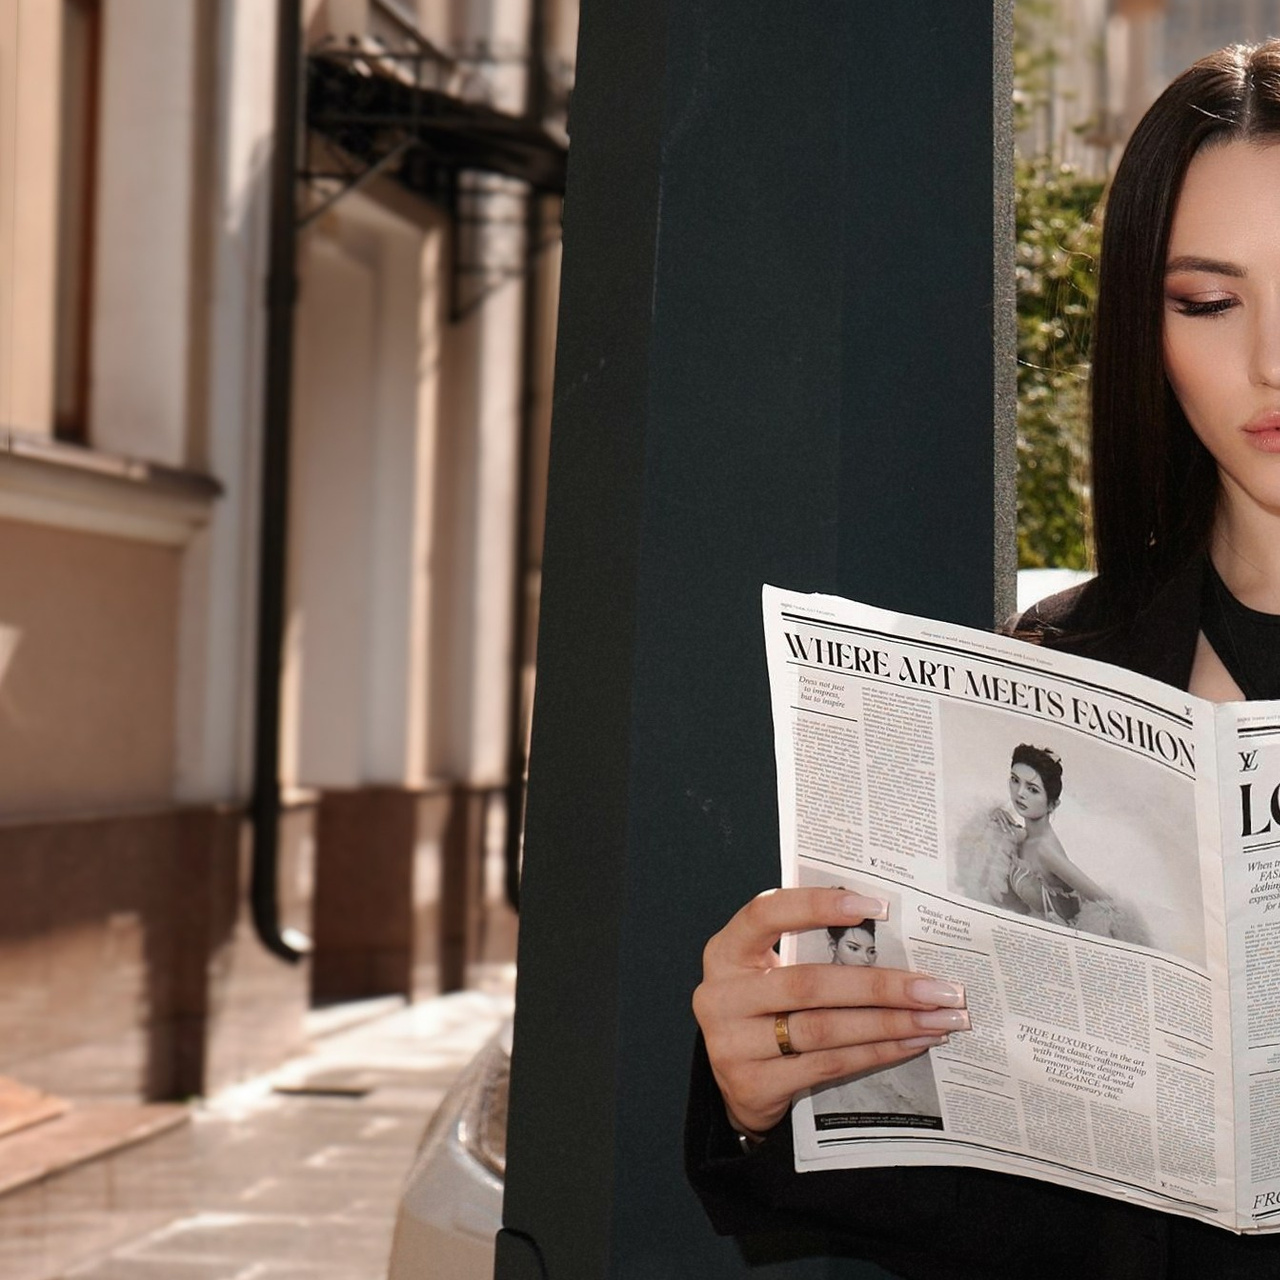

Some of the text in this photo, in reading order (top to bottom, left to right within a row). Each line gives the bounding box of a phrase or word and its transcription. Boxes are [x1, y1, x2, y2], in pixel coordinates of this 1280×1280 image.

[799, 675, 817, 686] Dress
[819, 680, 830, 688] not
[784, 632, 891, 678] WHERE
[899, 656, 955, 690] ART
[964, 670, 1065, 718] MEETS
[1072, 697, 1196, 772] FASHION
[801, 692, 812, 701] but
[822, 697, 845, 708] inspire
[812, 687, 840, 699] impress,
[1248, 861, 1272, 872] When
[917, 904, 970, 927] Classic charm
[1263, 901, 1277, 913] for
[921, 917, 938, 926] with
[947, 924, 969, 934] touch
[933, 928, 972, 941] tomorrow
[1019, 1024, 1049, 1038] TRUE
[1051, 1033, 1095, 1051] LUXURY
[1095, 1047, 1108, 1056] lies
[1120, 1054, 1132, 1063] the
[1017, 1033, 1147, 1076] of blending classic craftsmanship
[1032, 1047, 1051, 1057] with
[1054, 1049, 1095, 1069] innovative
[1097, 1064, 1126, 1080] designs,
[1033, 1054, 1135, 1089] harmony where old-world
[1045, 1066, 1124, 1094] ELEGANCE meets
[1048, 1076, 1102, 1097] contemporary
